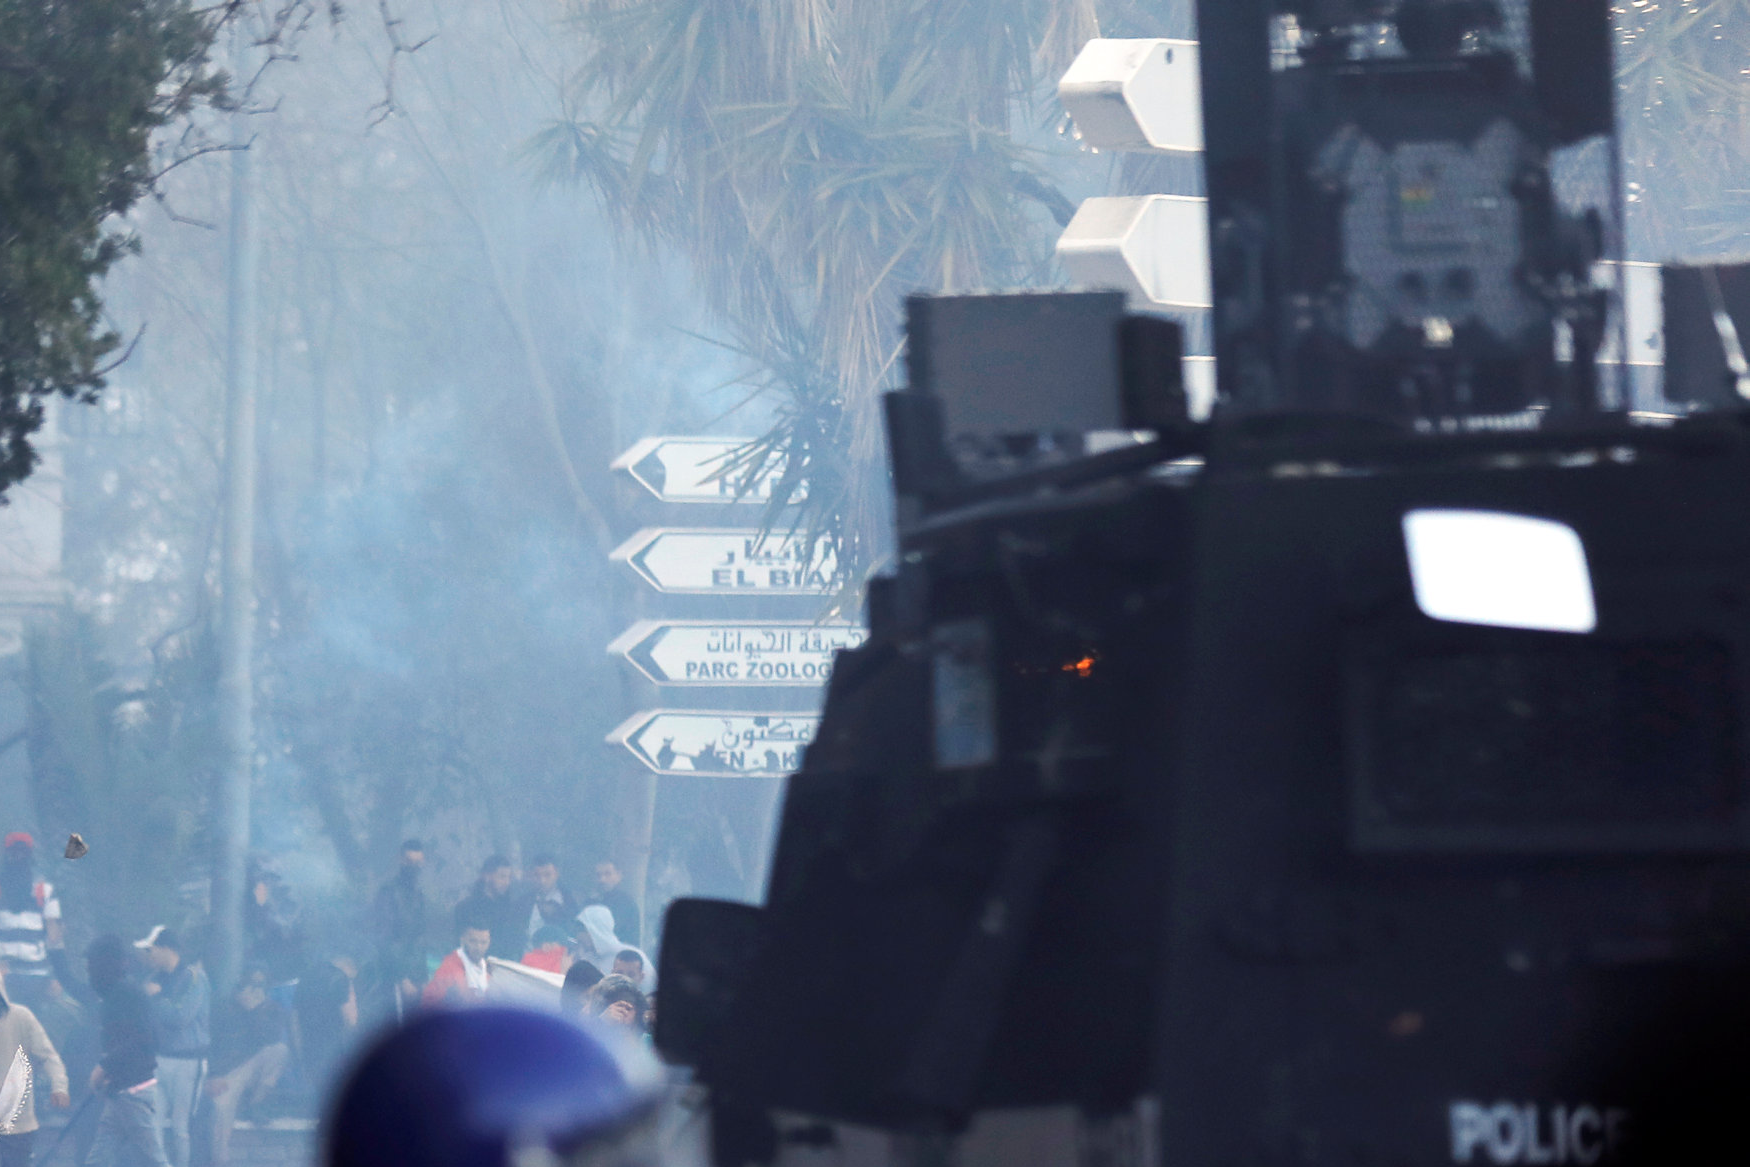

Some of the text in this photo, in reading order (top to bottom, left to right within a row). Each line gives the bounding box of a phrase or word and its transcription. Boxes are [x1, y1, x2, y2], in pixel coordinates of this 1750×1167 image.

[712, 569, 755, 587] EL
[707, 631, 791, 659] الحيوانات
[685, 662, 833, 680] PARC ZOOLOG
